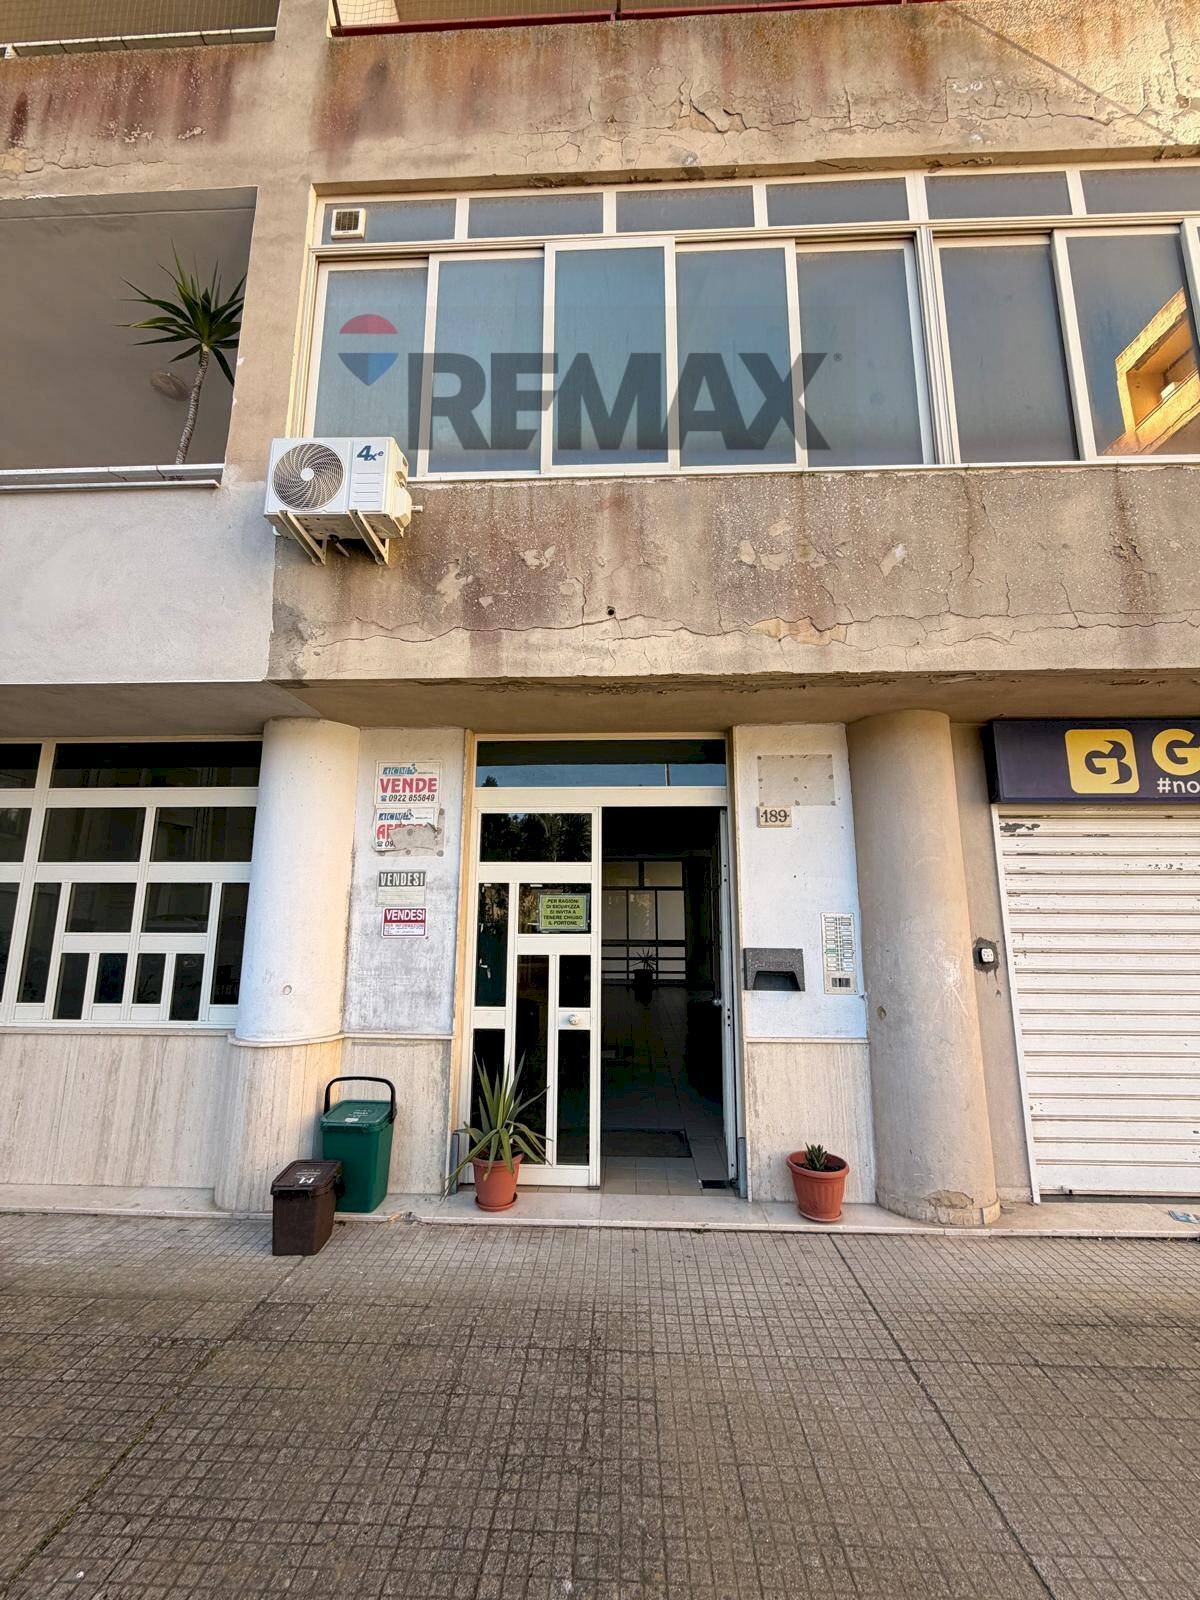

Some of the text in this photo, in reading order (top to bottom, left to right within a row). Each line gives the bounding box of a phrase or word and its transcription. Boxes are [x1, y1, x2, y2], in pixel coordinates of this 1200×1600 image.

[380, 778, 438, 793] VENDE
[388, 794, 407, 802] 0922
[762, 809, 788, 823] 189
[380, 872, 425, 886] VENDESI
[386, 909, 425, 920] VENDESI
